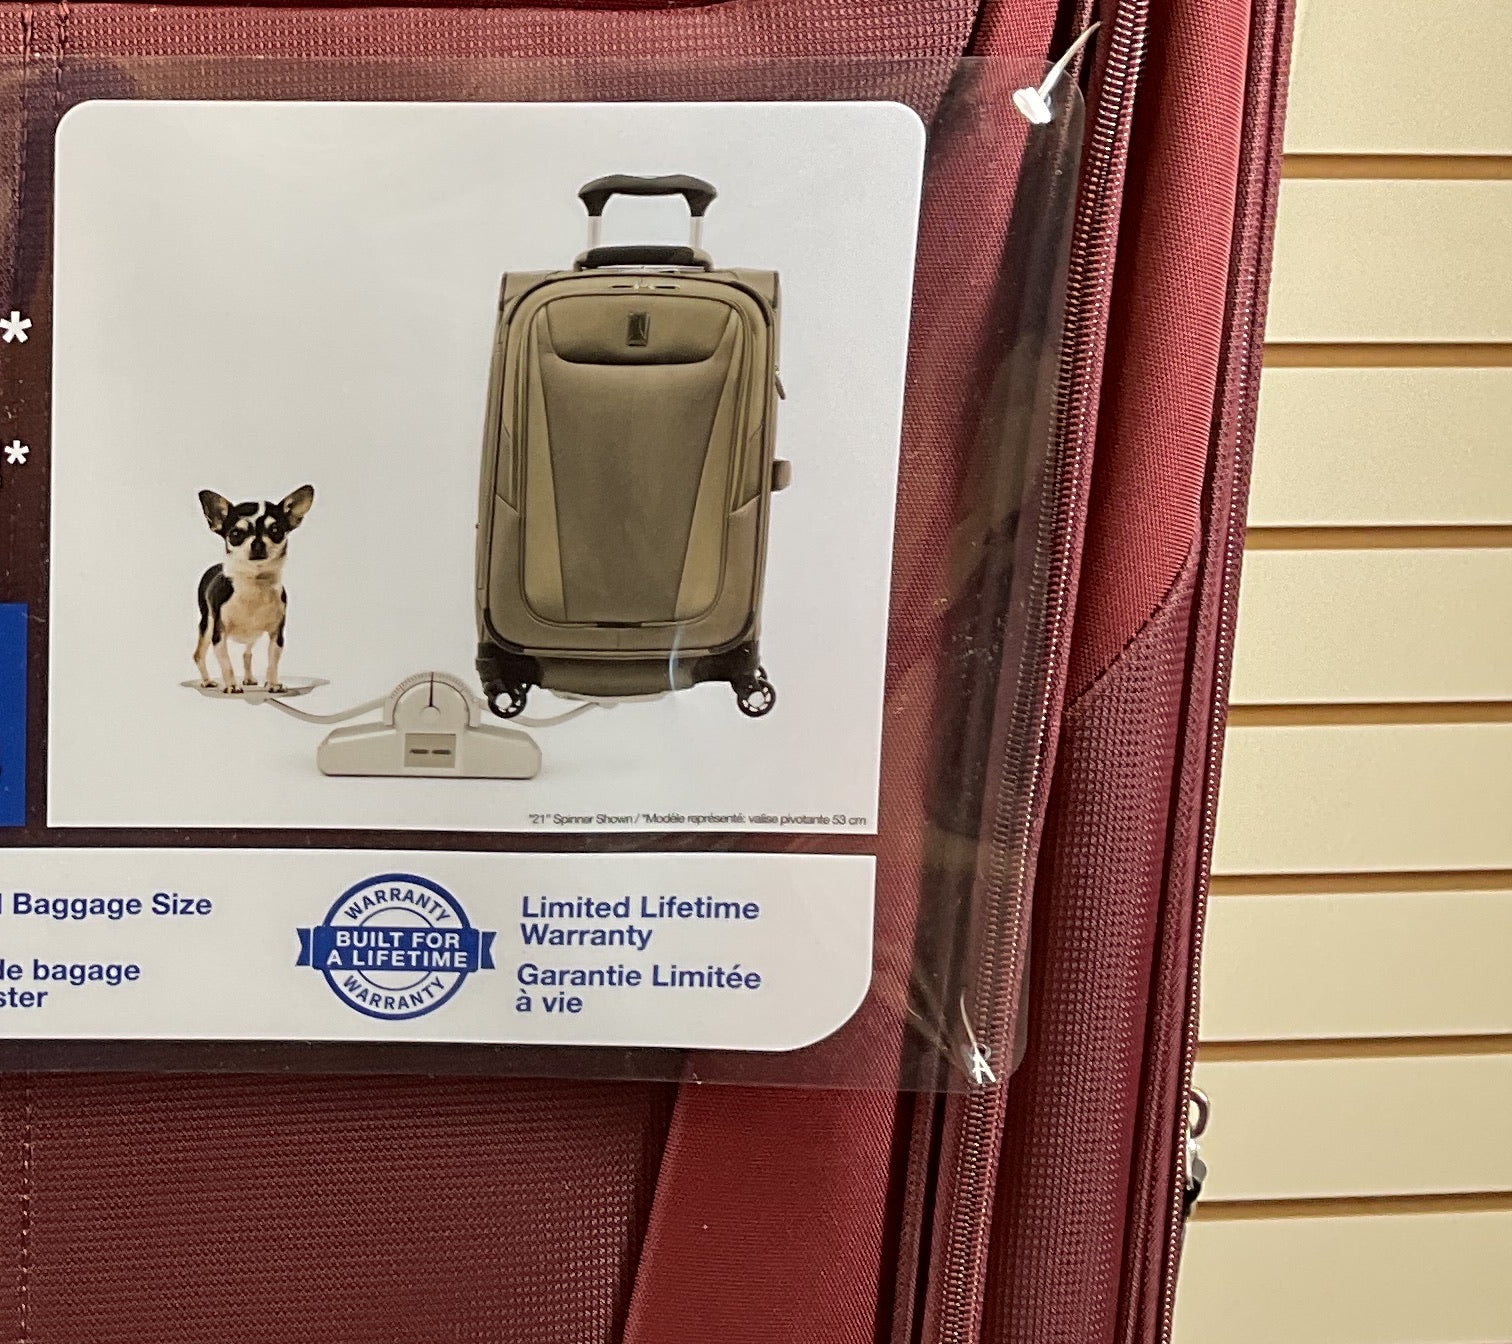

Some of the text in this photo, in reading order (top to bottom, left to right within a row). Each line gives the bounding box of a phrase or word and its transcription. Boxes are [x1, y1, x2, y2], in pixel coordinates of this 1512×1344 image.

[552, 813, 593, 826] Spinner
[595, 813, 633, 825] Shown
[748, 813, 779, 824] valise
[779, 814, 831, 826] pivotante
[831, 814, 847, 826] 53
[848, 817, 867, 826] cm
[13, 892, 142, 921] Baggage
[151, 892, 212, 916] Size
[344, 887, 451, 921] WARRANTY
[522, 895, 760, 920] Limited Lifetime
[336, 930, 460, 949] BUILT FOR
[520, 922, 653, 951] Warranty
[33, 958, 141, 986] bagage
[326, 949, 468, 968] A LIFETIME
[517, 963, 761, 990] Garantie Limitée
[343, 975, 445, 1010] WARRANTY
[515, 990, 583, 1014] à vie
